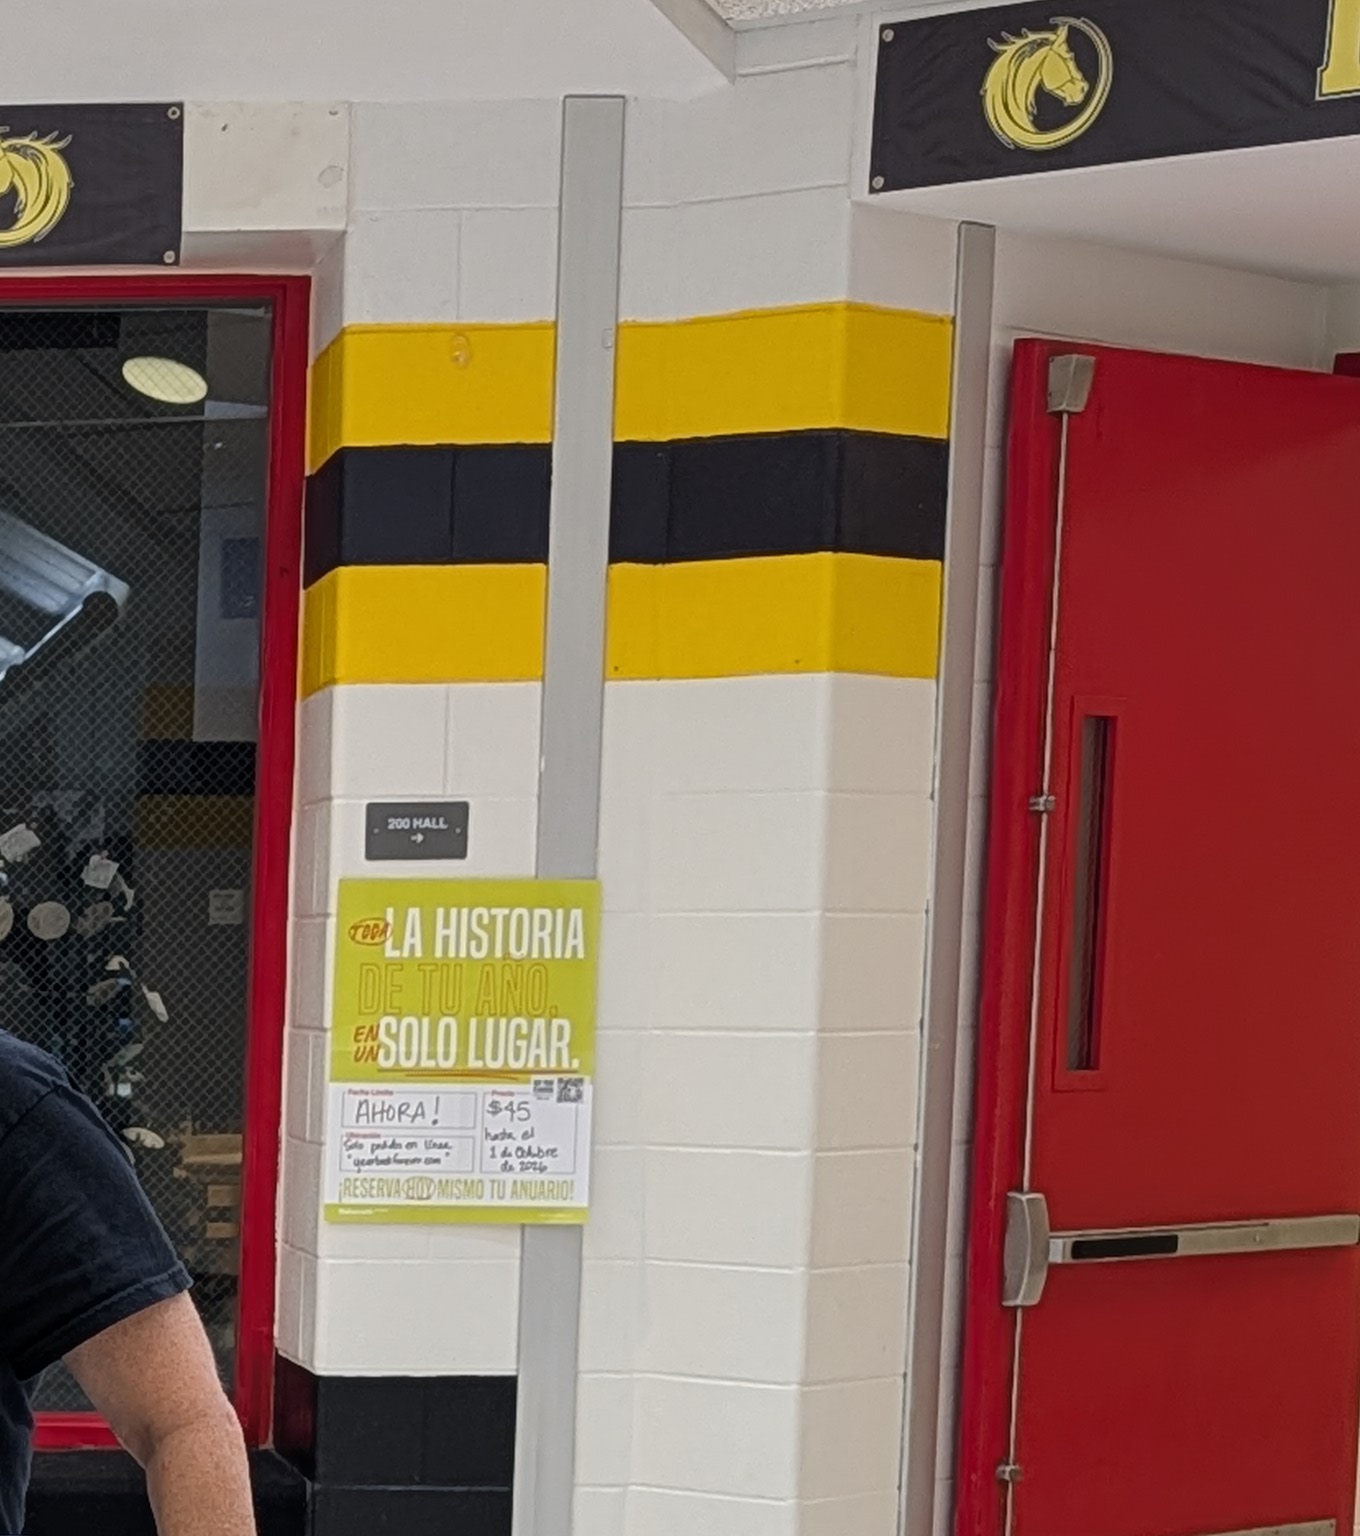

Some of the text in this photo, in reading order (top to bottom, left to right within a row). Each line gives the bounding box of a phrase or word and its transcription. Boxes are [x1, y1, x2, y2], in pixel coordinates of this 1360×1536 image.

[387, 817, 448, 829] 200 HALL
[384, 907, 585, 959] LA HISTORIA
[358, 963, 403, 1015] DE
[418, 963, 463, 1016] TU
[354, 1024, 380, 1043] EN
[379, 1015, 580, 1069] SOLO LUGAR.
[354, 1044, 381, 1063] UN
[486, 1100, 531, 1122] $45
[406, 1180, 432, 1200] HOY
[437, 1180, 484, 1200] MISMO
[490, 1181, 506, 1200] TU
[510, 1180, 574, 1201] ANUARIO!
